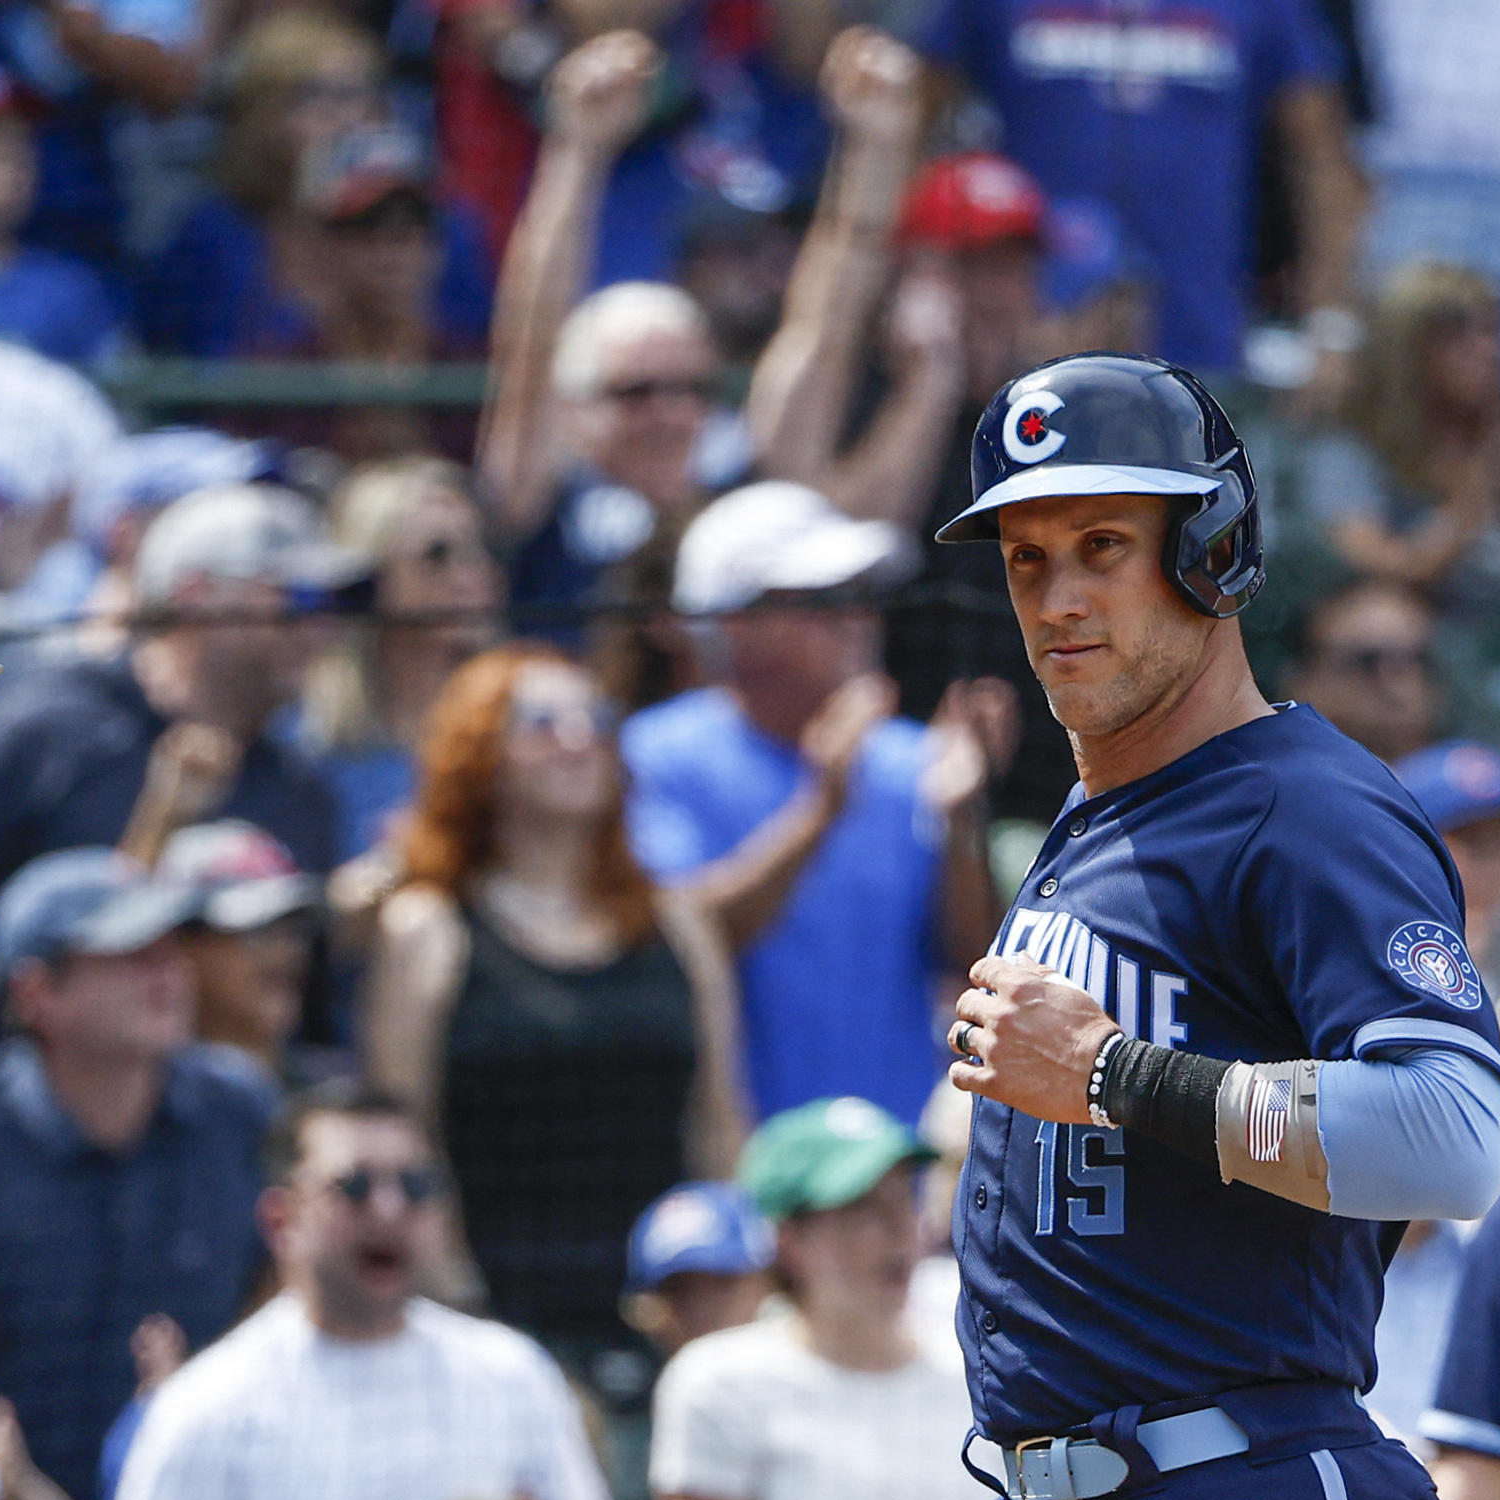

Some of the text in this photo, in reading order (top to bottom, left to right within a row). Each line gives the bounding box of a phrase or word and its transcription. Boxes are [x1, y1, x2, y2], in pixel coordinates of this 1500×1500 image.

[1002, 390, 1067, 464] C
[1393, 926, 1472, 974] CHICAGO
[1035, 1120, 1125, 1236] 15
